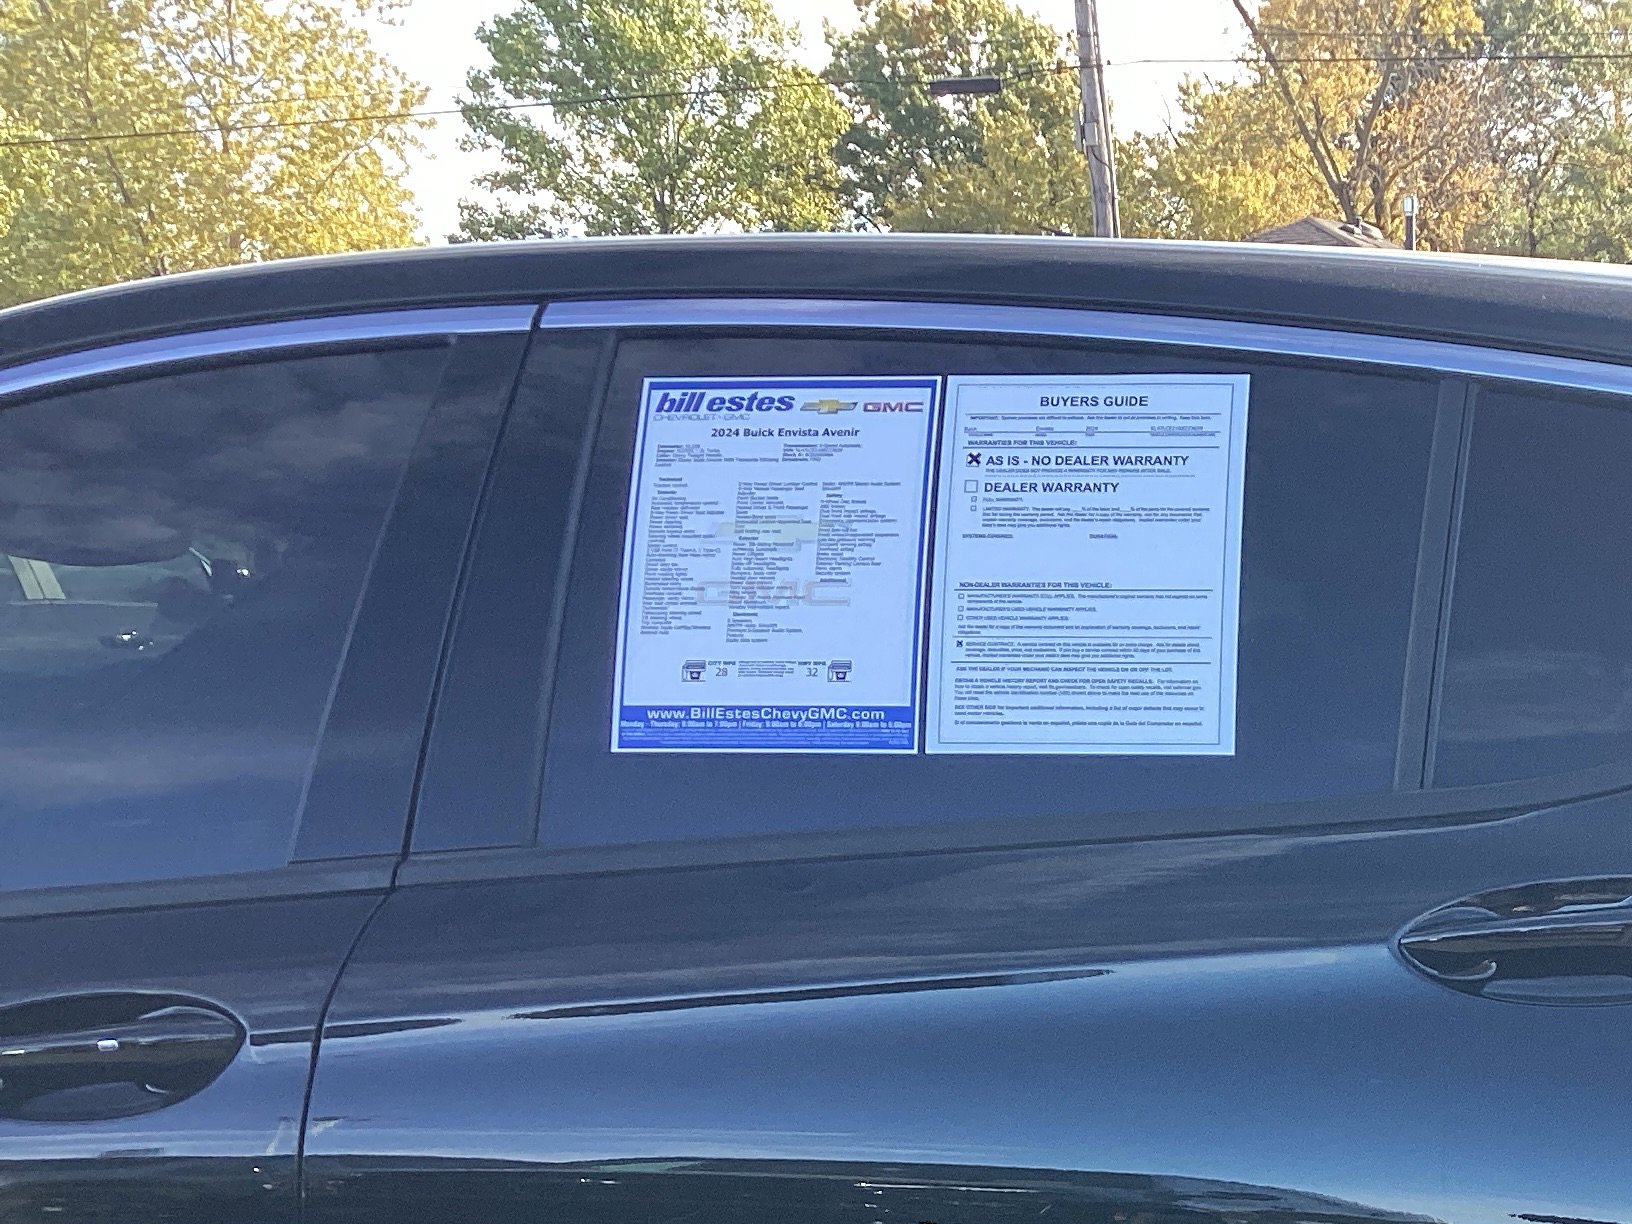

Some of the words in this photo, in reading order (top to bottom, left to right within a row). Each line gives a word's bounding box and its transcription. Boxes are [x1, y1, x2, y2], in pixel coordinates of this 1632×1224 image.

[655, 391, 706, 413] bill
[706, 391, 796, 412] estes
[1039, 395, 1099, 407] BUYERS
[1103, 395, 1150, 407] GUIDE
[863, 402, 924, 413] GMC
[724, 413, 751, 421] GMC
[711, 428, 740, 437] 2024
[743, 427, 774, 437] Buick
[778, 427, 819, 437] Envista
[822, 427, 860, 437] Avenir
[985, 455, 1004, 466] AS
[1007, 455, 1020, 466] IS
[1031, 455, 1051, 466] NO
[1055, 455, 1109, 466] DEALER
[1112, 455, 1190, 466] WARRANTY
[984, 482, 1039, 493] DEALER
[1042, 482, 1120, 493] WARRANTY
[715, 667, 728, 677] 28
[805, 667, 818, 677] 32
[647, 707, 885, 721] www.BillEstesChevyGMC.com
[620, 720, 645, 729] Monday
